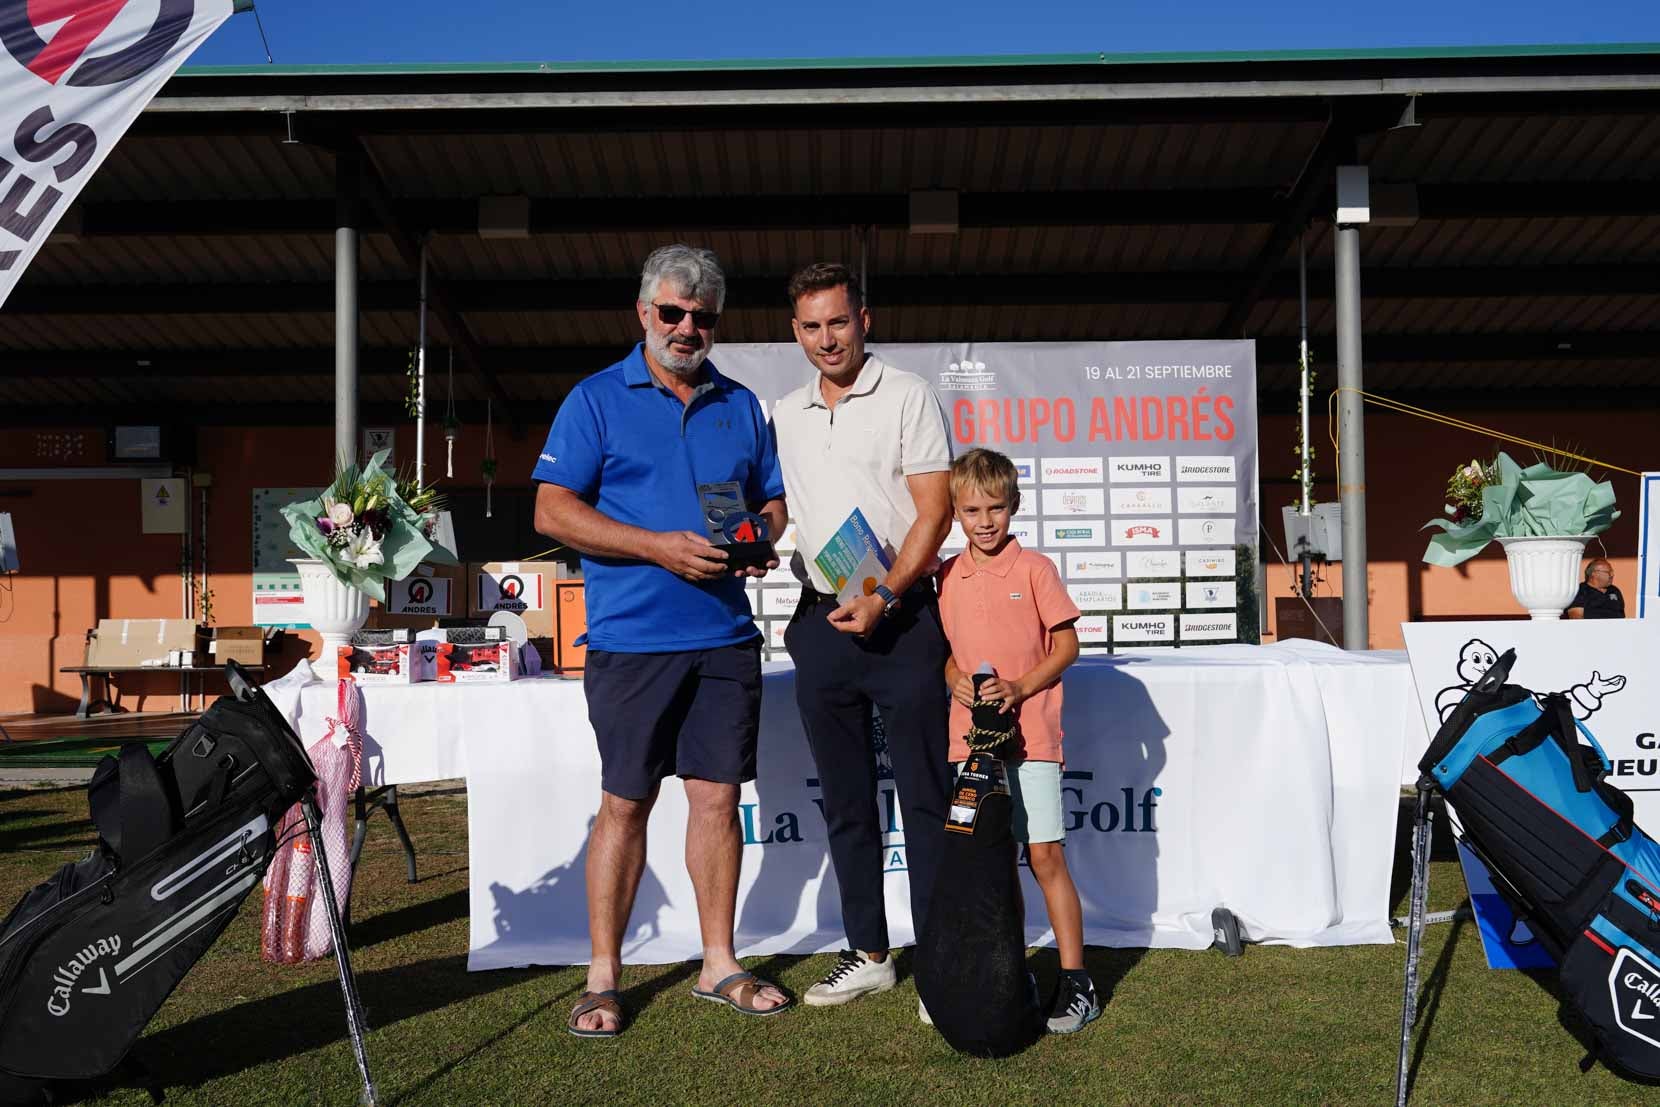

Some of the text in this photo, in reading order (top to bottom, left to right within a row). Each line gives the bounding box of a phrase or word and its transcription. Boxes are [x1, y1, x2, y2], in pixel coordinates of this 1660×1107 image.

[0, 105, 97, 270] ES
[1085, 365, 1232, 380] 19 AL 21 SEPTIEMBRE
[953, 386, 1235, 444] GRUPO ANDRÉS
[1117, 463, 1162, 471] KUMHO
[1181, 465, 1231, 473] BRIDGESTONE
[1121, 622, 1166, 630] KUMHO
[1184, 623, 1232, 632] BRIDGESTONE
[1635, 733, 1660, 750] G
[738, 803, 804, 845] La
[1062, 787, 1163, 833] Golf
[47, 934, 121, 1016] Callaway
